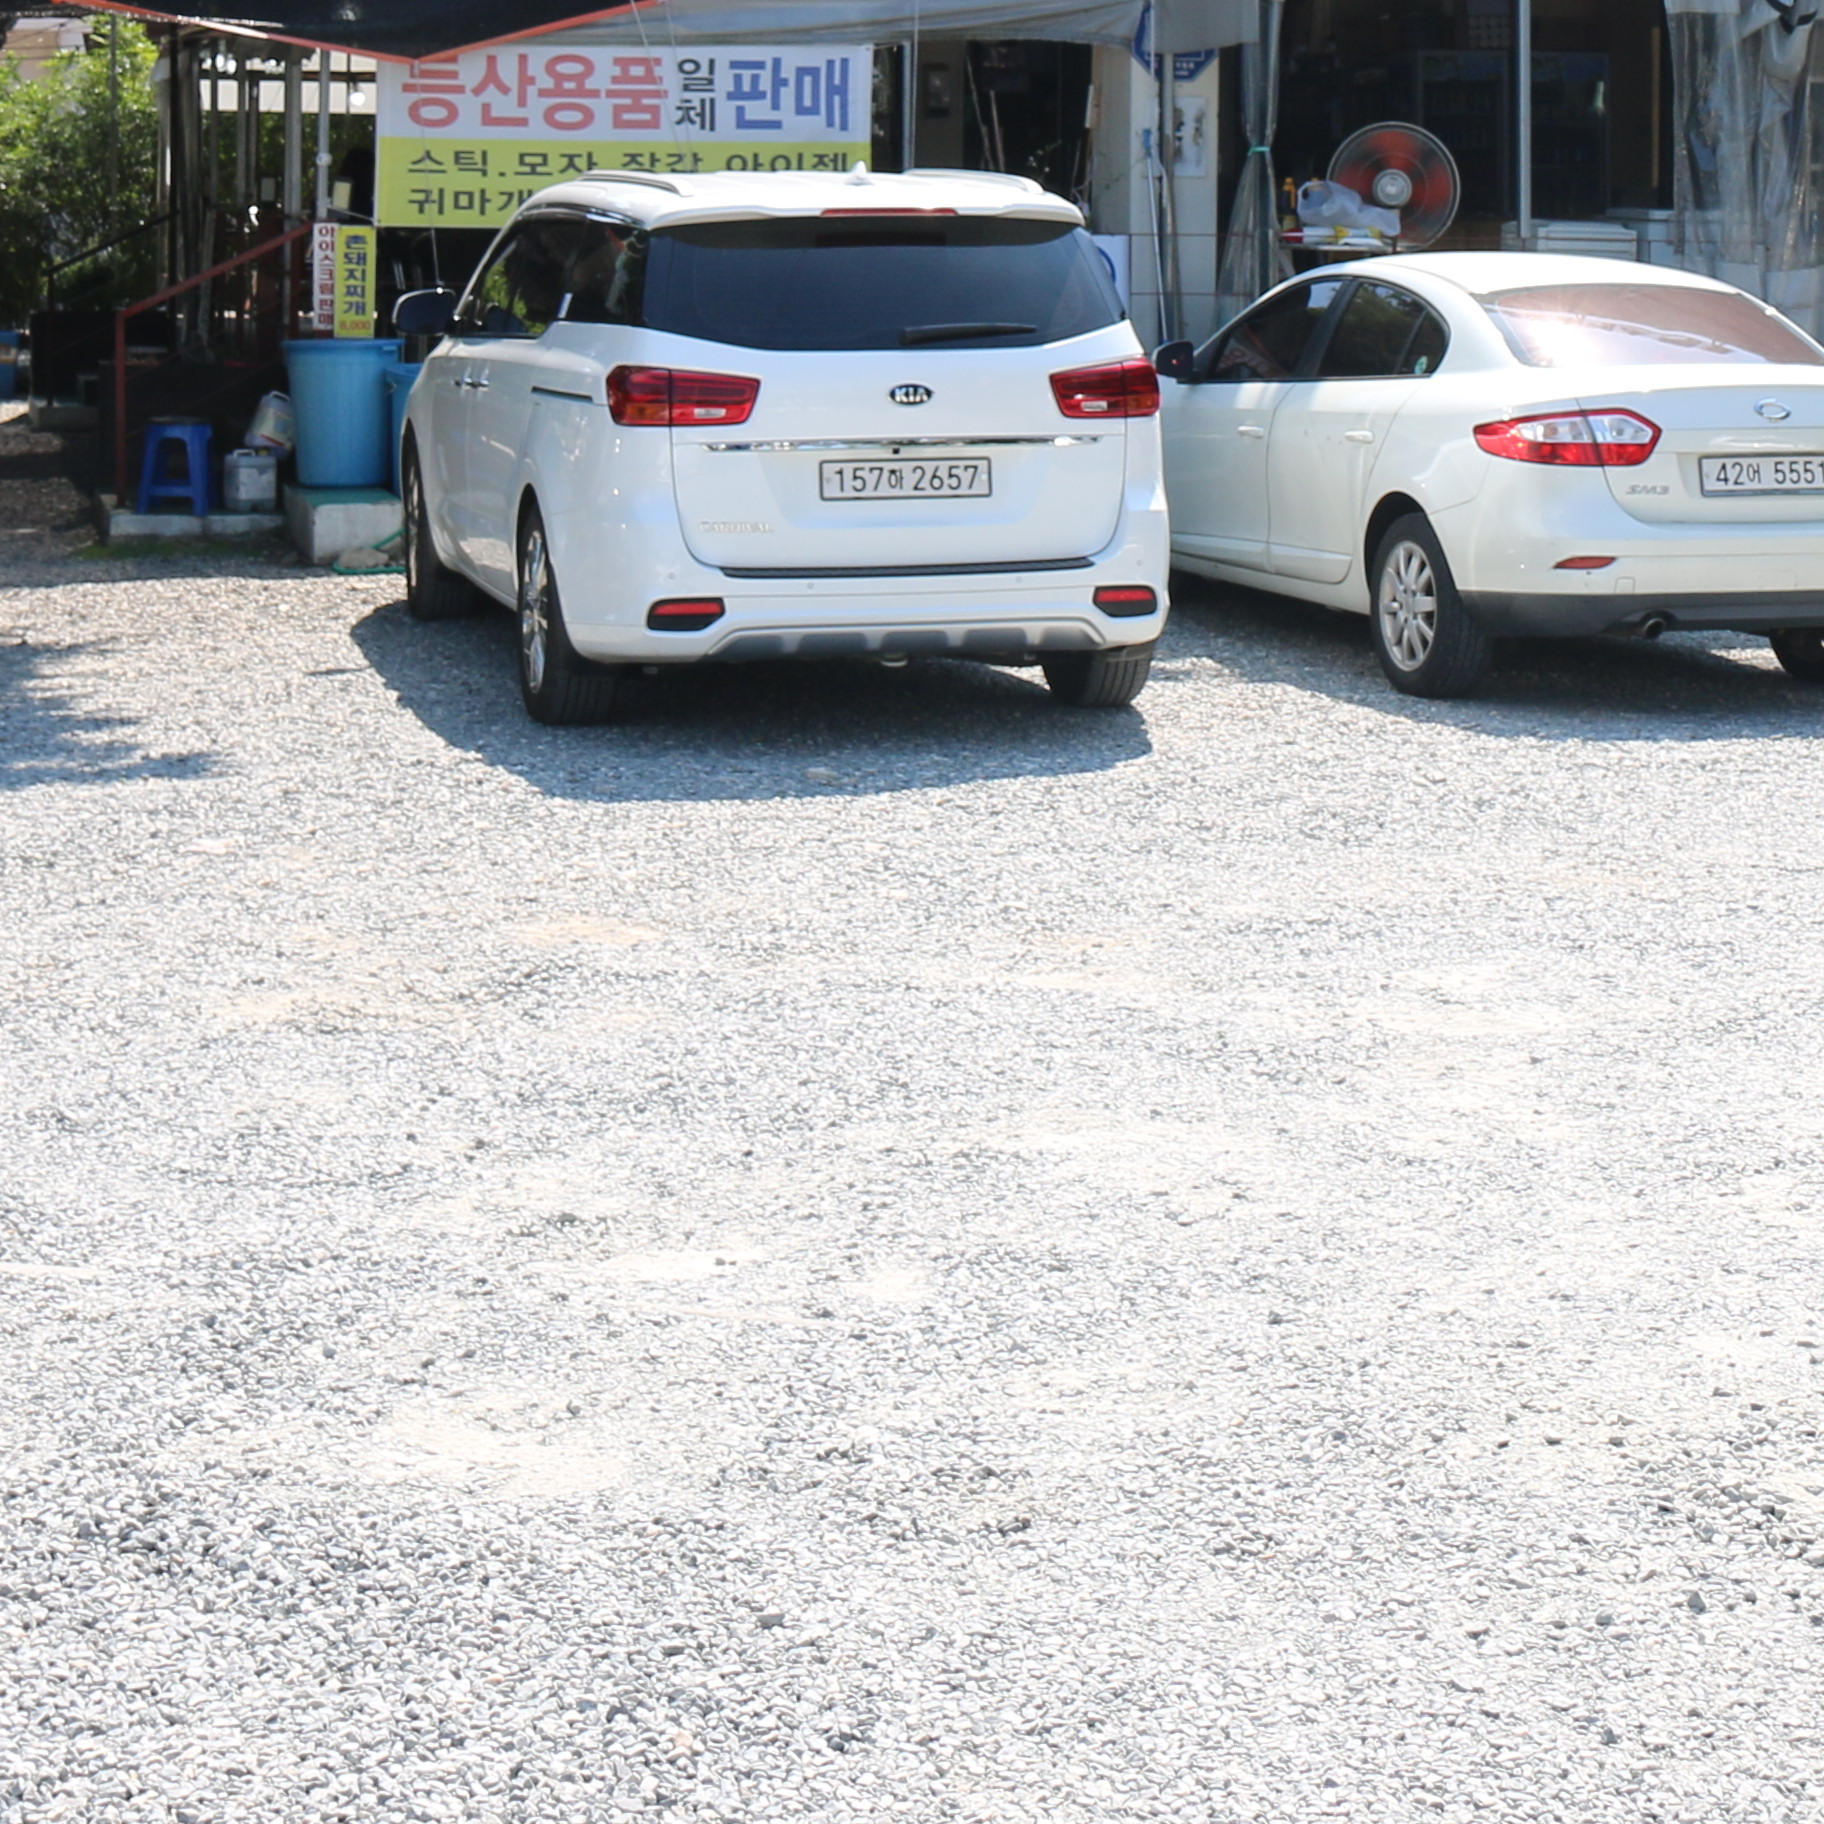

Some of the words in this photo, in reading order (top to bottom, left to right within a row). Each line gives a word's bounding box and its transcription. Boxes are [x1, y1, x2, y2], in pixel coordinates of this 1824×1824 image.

[402, 53, 669, 132] 등산용품
[726, 57, 850, 132] 판매
[894, 386, 929, 403] KIA
[912, 464, 979, 492] 2657
[1715, 462, 1762, 486] 42어
